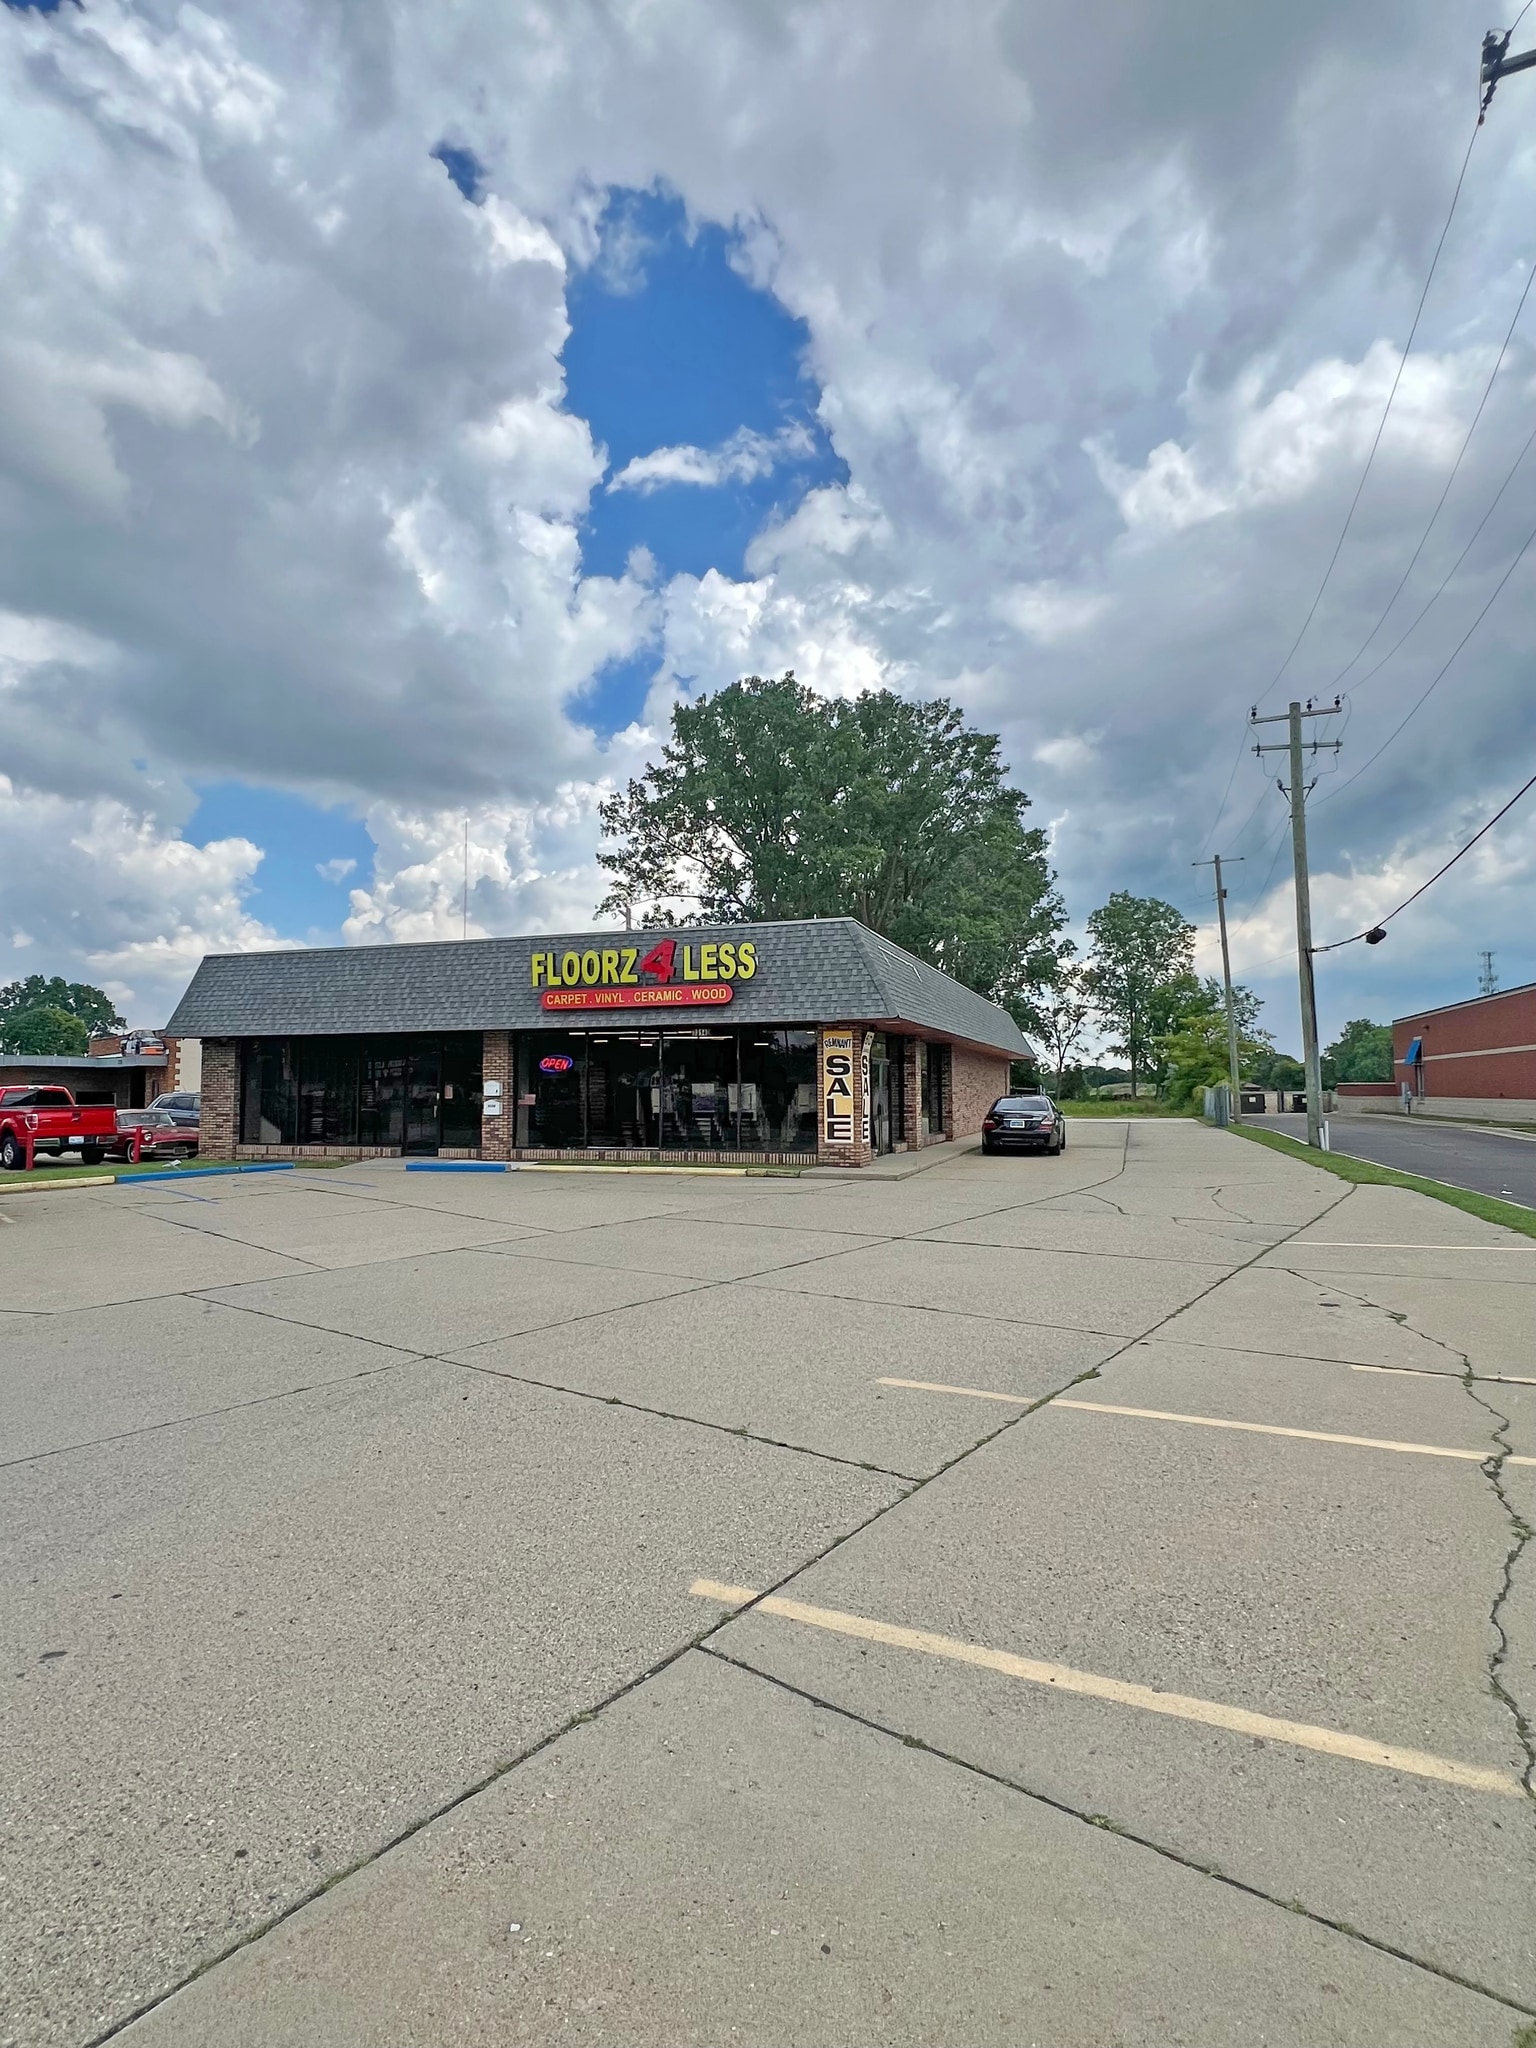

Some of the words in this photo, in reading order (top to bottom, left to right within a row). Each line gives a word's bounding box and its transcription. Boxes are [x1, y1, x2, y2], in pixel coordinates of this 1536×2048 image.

[531, 948, 638, 987] FLOORZ
[641, 939, 676, 984] 4
[682, 942, 757, 982] LESS
[547, 994, 587, 1005] CARPET
[595, 992, 625, 1004] VINYL
[634, 990, 682, 1002] CERAMIC
[692, 988, 726, 1000] WOOD
[824, 1039, 852, 1049] REMNANT
[541, 1057, 569, 1070] OPEN
[826, 1055, 851, 1140] SALE
